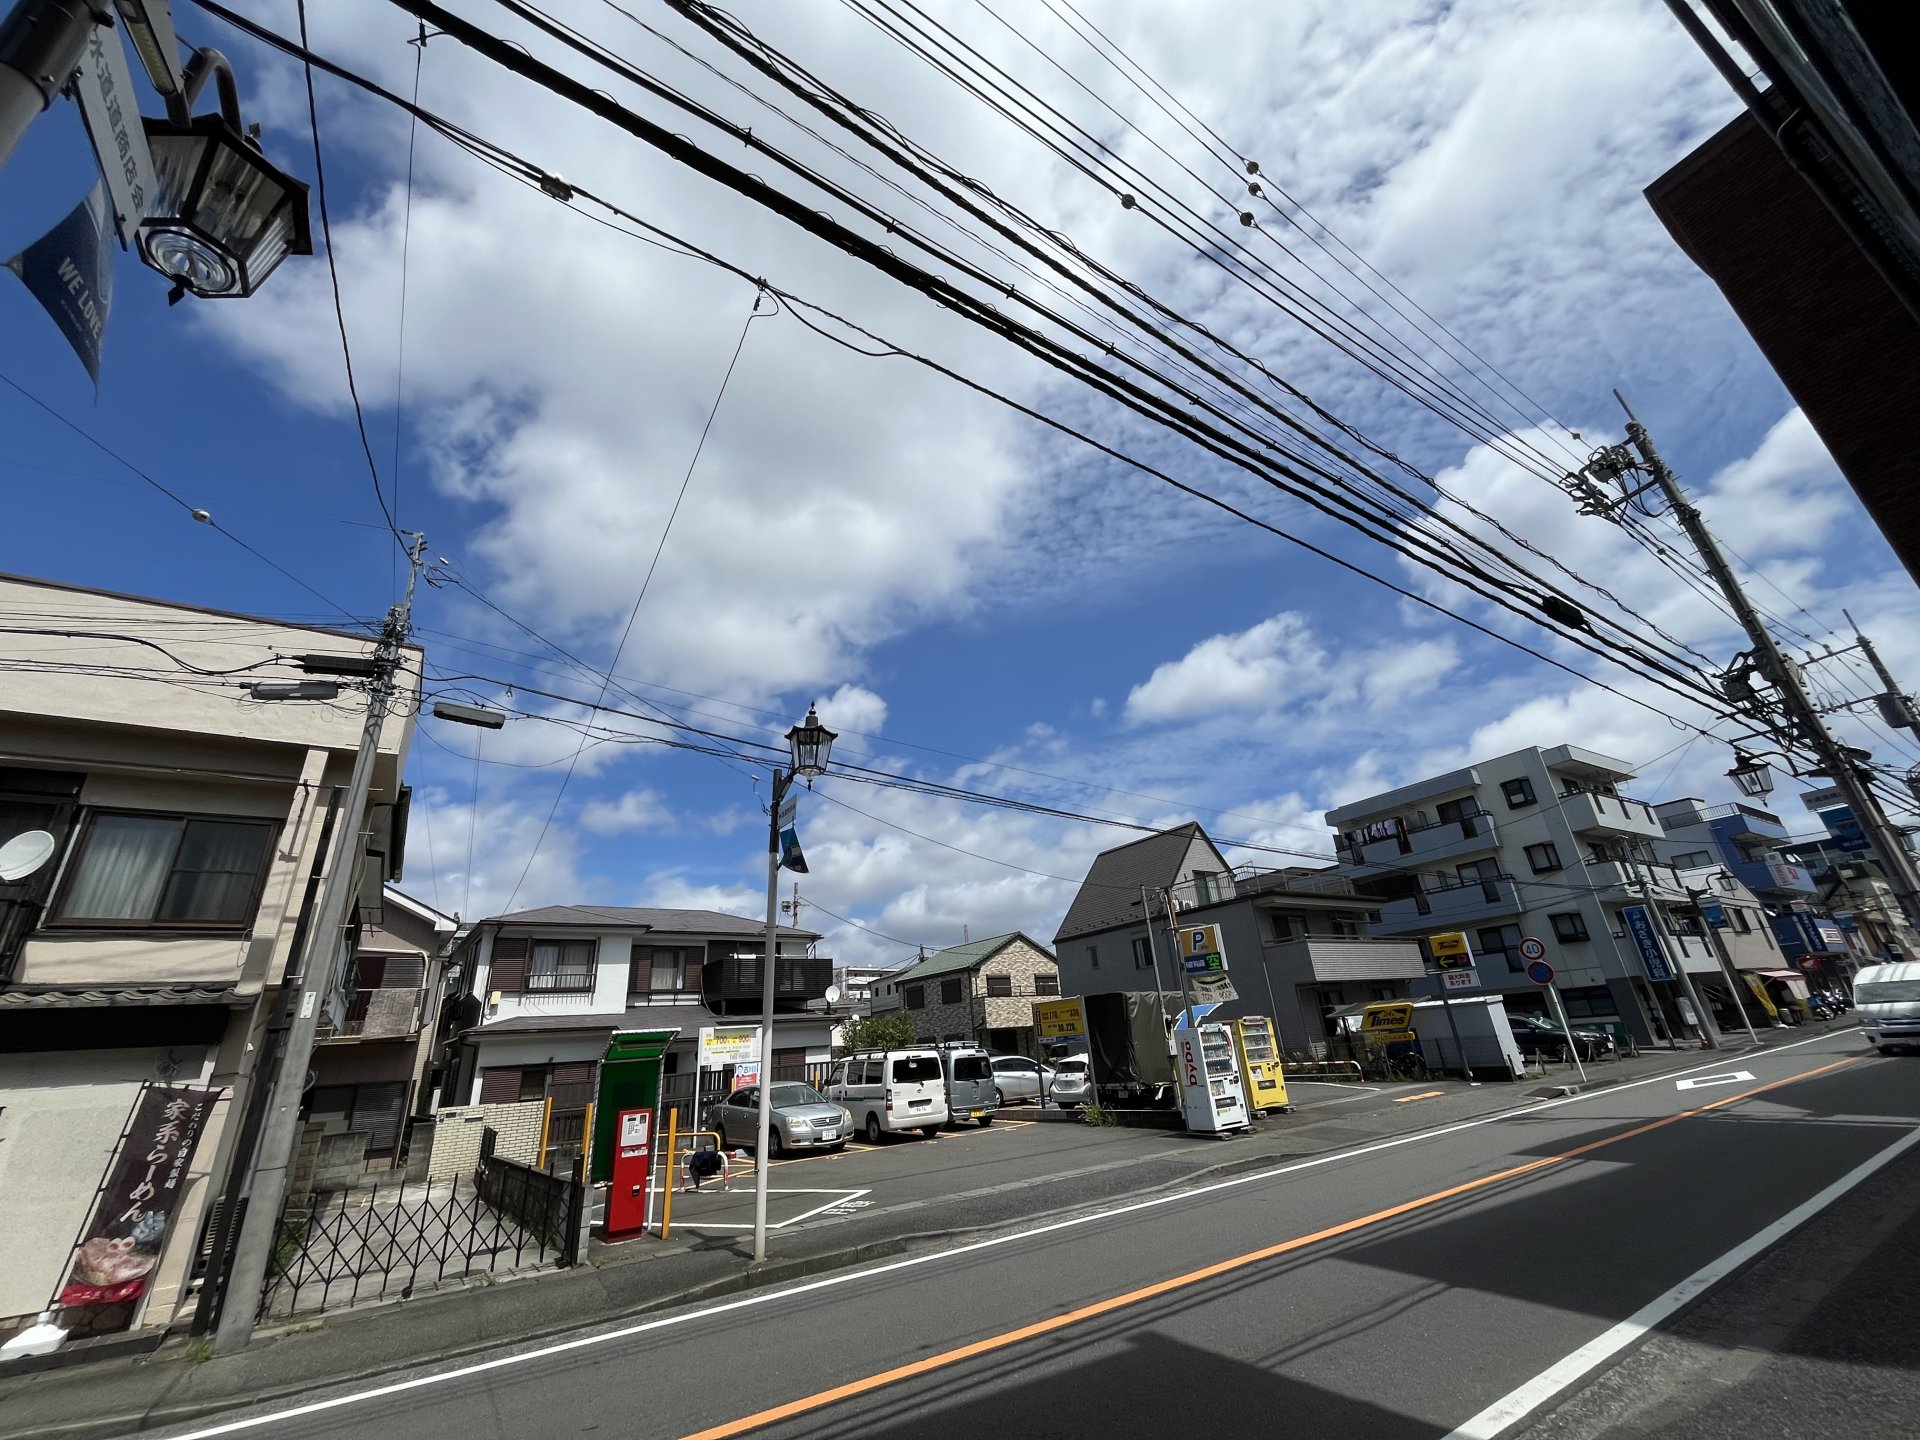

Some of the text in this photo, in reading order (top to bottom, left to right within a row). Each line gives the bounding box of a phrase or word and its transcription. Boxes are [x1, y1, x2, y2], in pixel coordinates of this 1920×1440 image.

[56, 255, 82, 299] WE
[1192, 930, 1205, 952] P
[1525, 942, 1540, 956] 40
[1205, 953, 1222, 970] 空
[1370, 1014, 1405, 1027] Times
[119, 1098, 191, 1223] 家系らーめん
